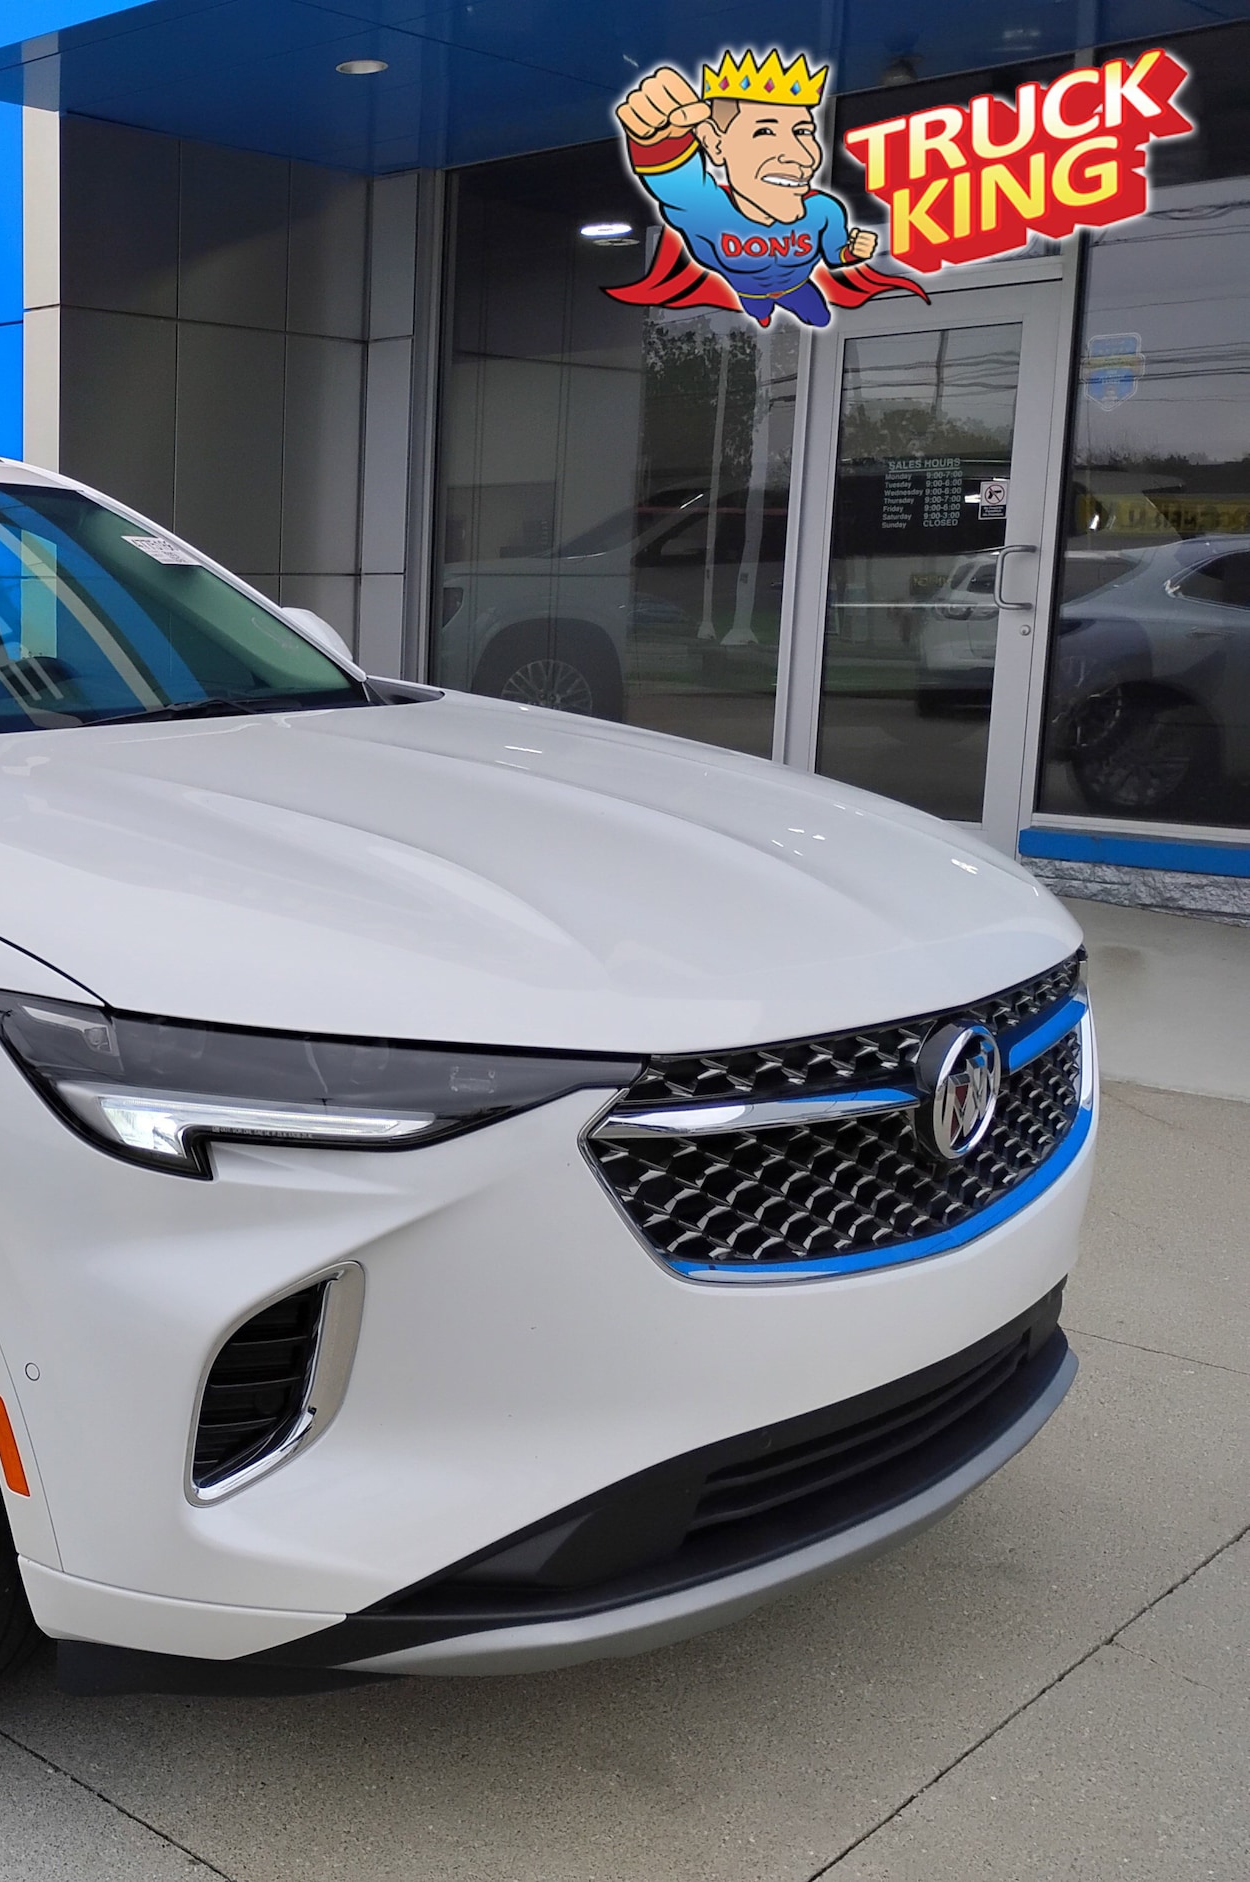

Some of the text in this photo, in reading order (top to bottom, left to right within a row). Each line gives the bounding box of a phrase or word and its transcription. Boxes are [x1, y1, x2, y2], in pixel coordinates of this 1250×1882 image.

[889, 458, 960, 470] SALES HOURS
[885, 473, 912, 481] Monday
[885, 481, 912, 489] Tuesday
[884, 489, 923, 497] Wednesday
[882, 505, 904, 513] Friday
[882, 513, 912, 521] Saturday
[881, 519, 958, 529] Sunday CLOSED
